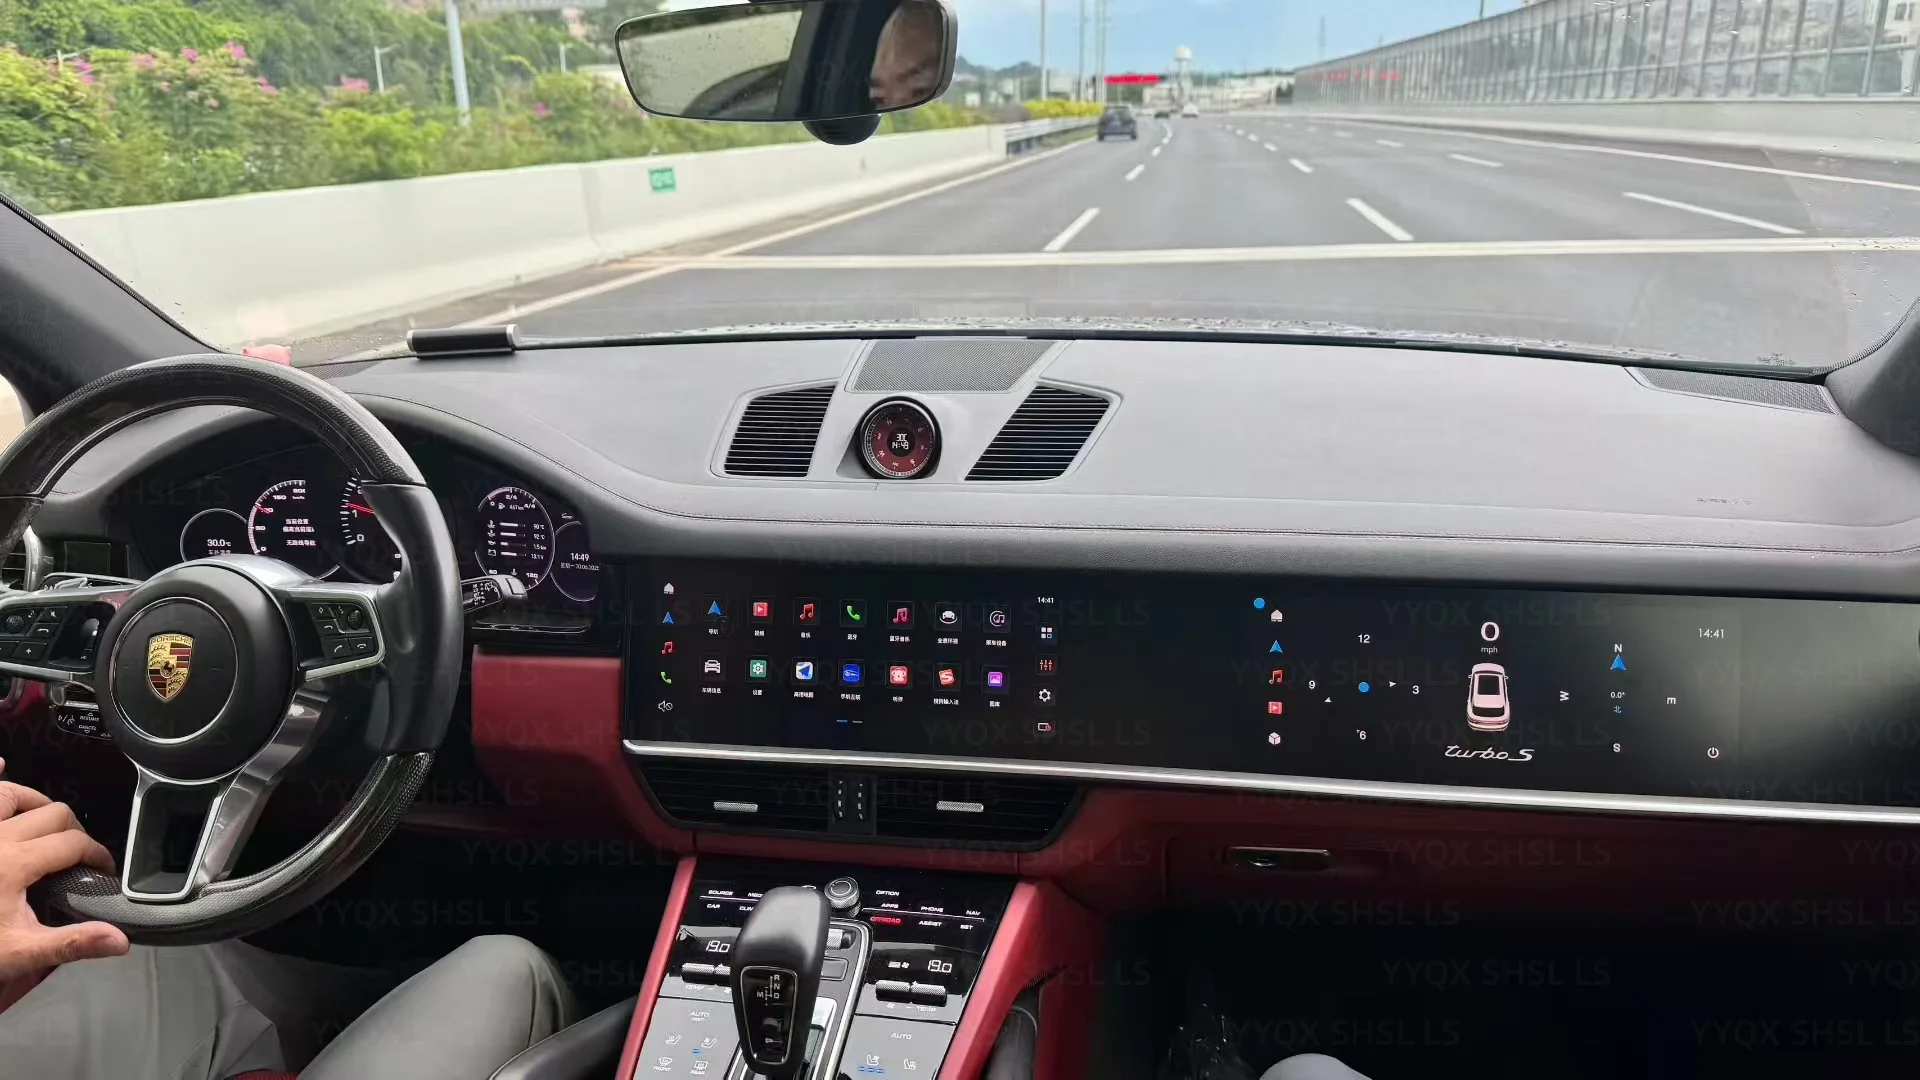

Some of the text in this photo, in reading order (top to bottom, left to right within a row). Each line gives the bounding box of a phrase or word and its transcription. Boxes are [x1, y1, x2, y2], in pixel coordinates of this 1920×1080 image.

[570, 552, 590, 562] 14:49
[1480, 621, 1500, 642] 0
[1698, 628, 1724, 639] 14:41
[150, 635, 192, 644] PORSCHE
[1357, 633, 1371, 644] 12
[1480, 647, 1498, 655] mph
[1614, 643, 1623, 653] N
[1308, 680, 1316, 689] 9
[1412, 685, 1420, 694] 3
[1359, 730, 1367, 739] 6
[1613, 742, 1621, 753] S
[1444, 744, 1535, 762] turbo S
[705, 940, 731, 953] 19.0
[928, 959, 952, 973] 19.0
[891, 1032, 912, 1040] AUTO
